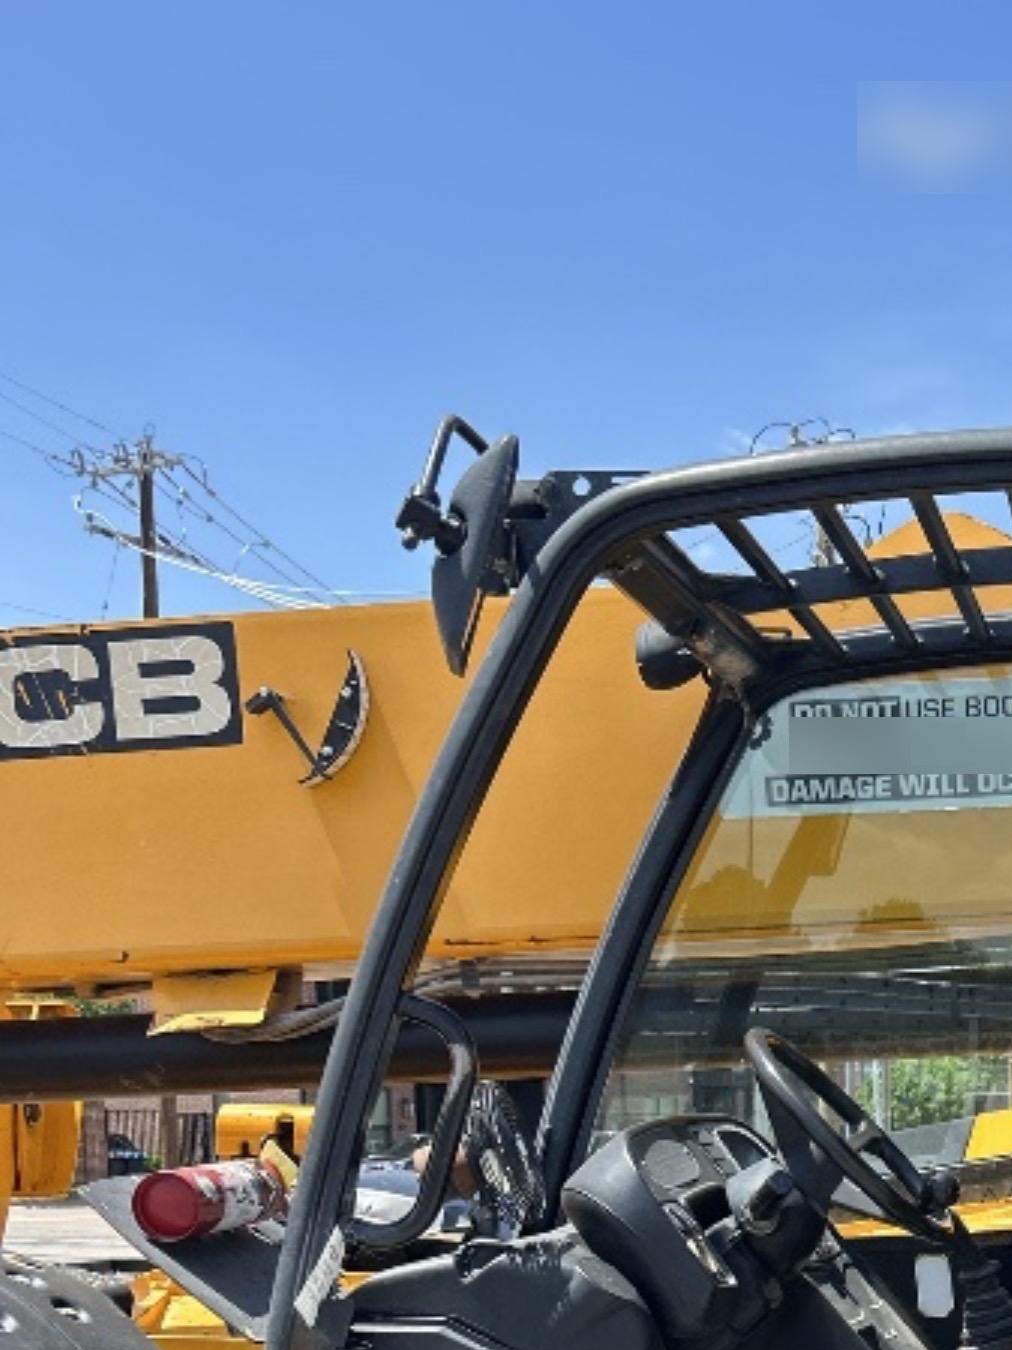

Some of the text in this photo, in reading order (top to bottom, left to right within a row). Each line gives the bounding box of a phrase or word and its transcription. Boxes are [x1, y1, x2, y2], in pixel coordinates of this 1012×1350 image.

[904, 698, 955, 718] USE
[771, 775, 892, 803] DAMAGE
[899, 772, 970, 798] WILL
